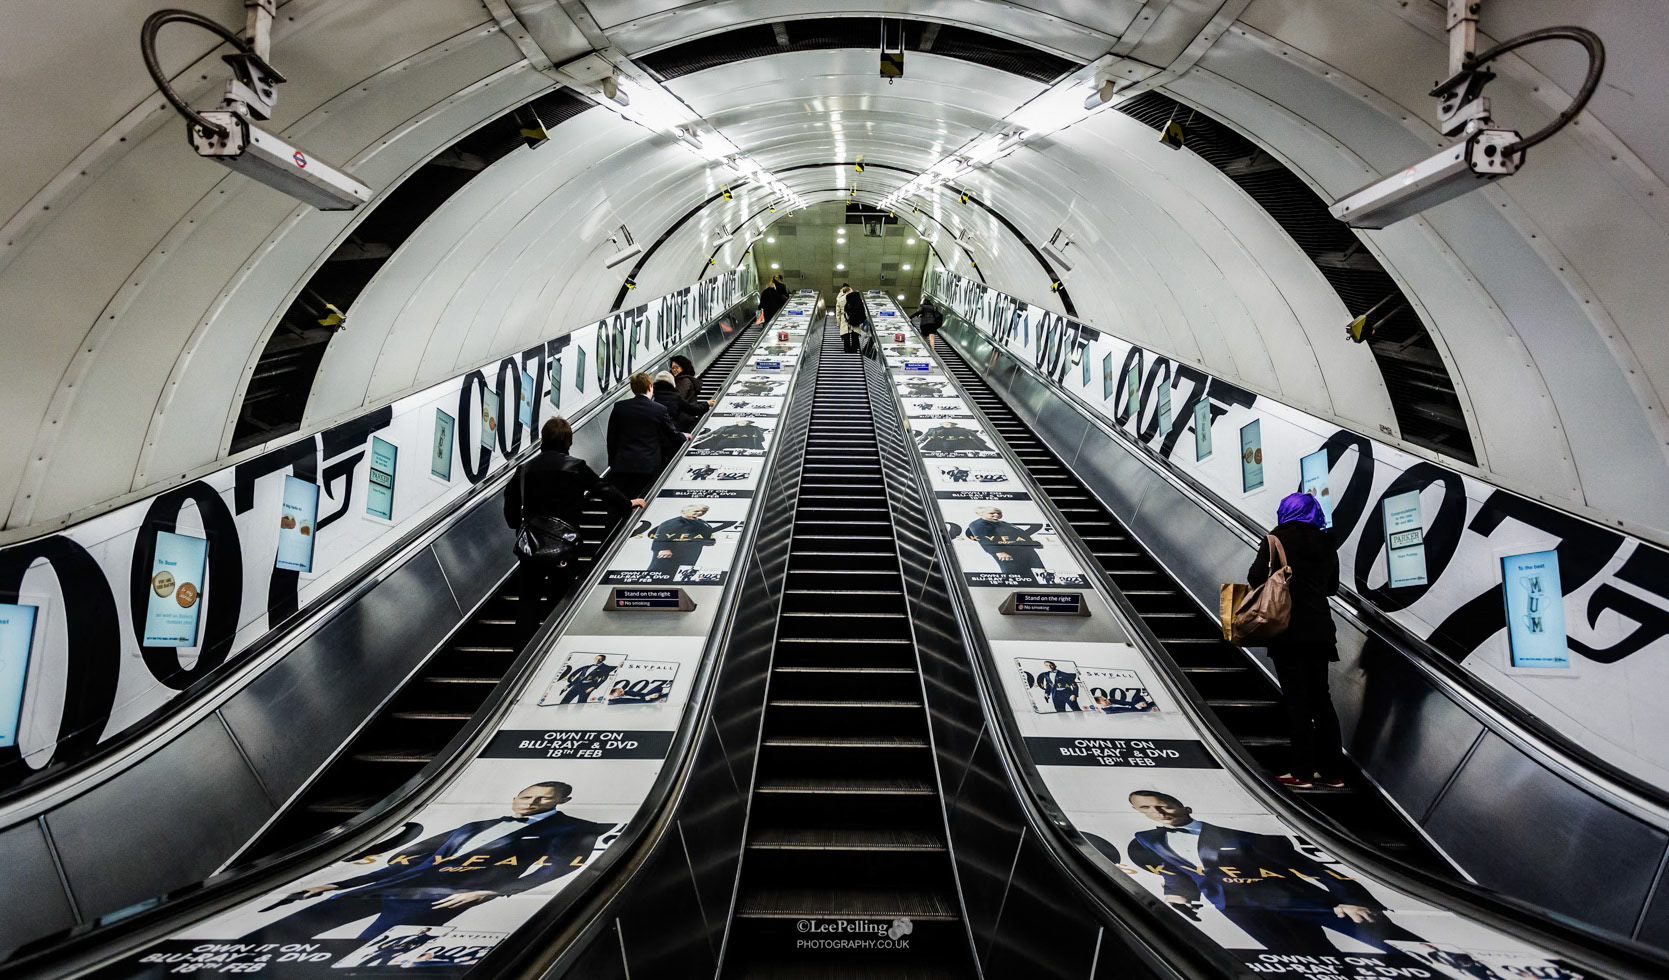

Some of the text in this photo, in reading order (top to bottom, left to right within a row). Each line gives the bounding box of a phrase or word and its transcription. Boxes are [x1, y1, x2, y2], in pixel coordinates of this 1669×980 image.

[1114, 345, 1209, 459] 007
[458, 342, 547, 487] 007
[1393, 532, 1420, 544] PARKER
[1298, 429, 1625, 664] 007
[657, 591, 671, 599] right
[1058, 596, 1071, 604] right
[0, 436, 321, 776] 007
[544, 732, 624, 740] OWN IT ON
[605, 741, 638, 749] DVD
[1075, 740, 1112, 748] OWN
[1130, 741, 1155, 749] ON
[546, 749, 602, 758] 18TH FEB
[1146, 749, 1179, 758] DVD
[1096, 757, 1155, 766] 18TH FEB
[353, 854, 587, 866] SKYFALL
[1119, 863, 1356, 880] SKYFALL
[192, 944, 320, 952] OWN IT ON
[254, 954, 273, 962] &
[276, 953, 332, 962] DVD
[1259, 954, 1386, 967] OWN IT ON
[170, 963, 267, 973] 18TH FEB
[1357, 968, 1374, 976] &
[1375, 967, 1431, 978] DVD
